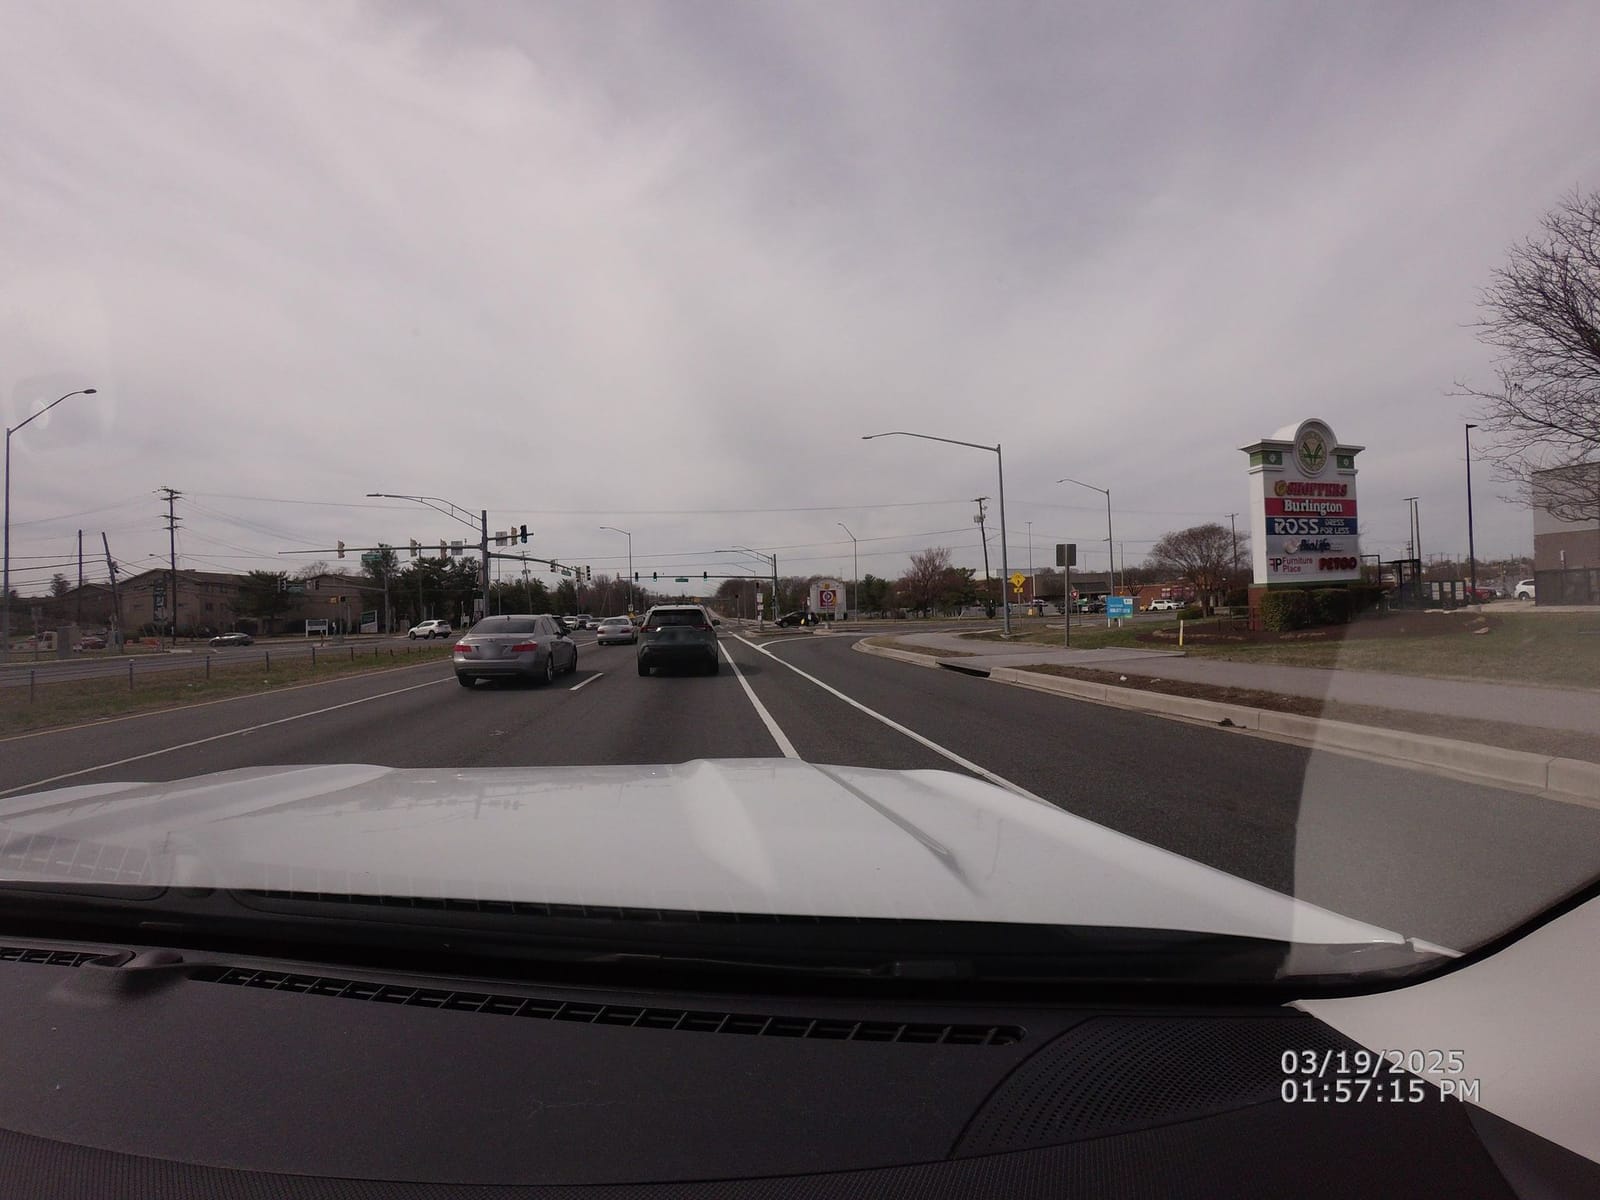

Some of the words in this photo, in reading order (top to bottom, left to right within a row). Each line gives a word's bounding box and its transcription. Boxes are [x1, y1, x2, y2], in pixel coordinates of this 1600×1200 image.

[1284, 500, 1343, 516] Burlington
[1274, 518, 1319, 534] ROSS
[1283, 557, 1312, 565] Furniture
